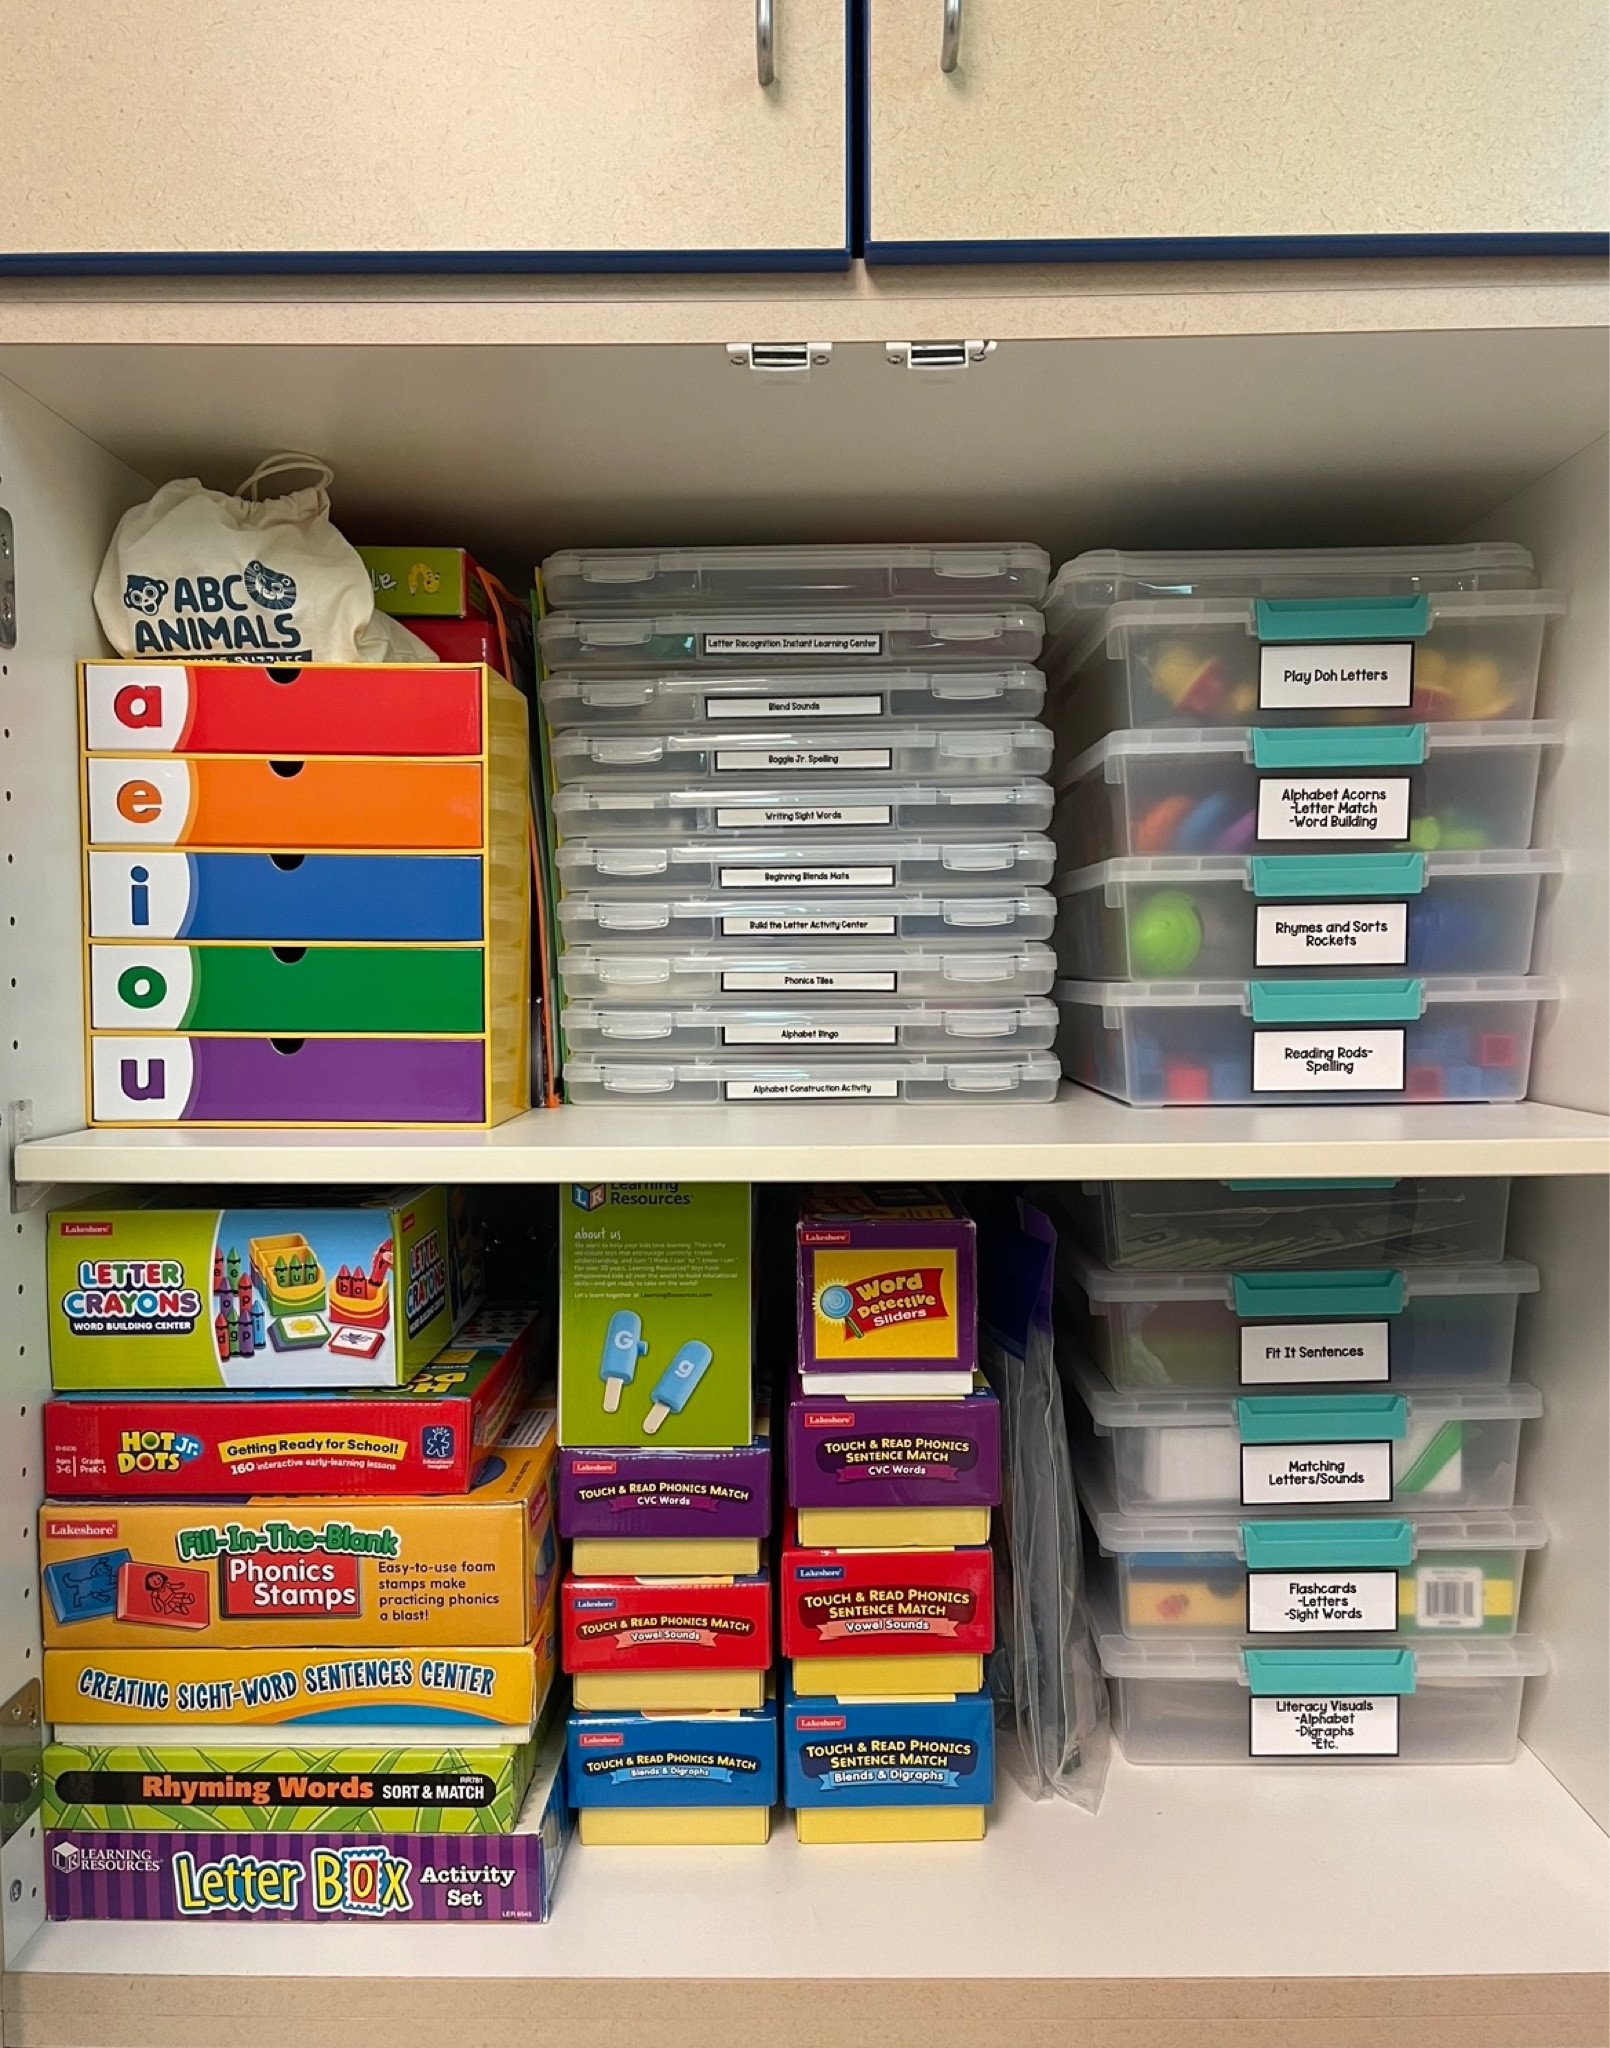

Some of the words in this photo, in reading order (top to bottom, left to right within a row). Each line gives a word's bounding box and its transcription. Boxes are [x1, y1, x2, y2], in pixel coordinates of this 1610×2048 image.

[174, 574, 248, 612] ABC
[135, 612, 300, 653] ANIMALS
[708, 640, 733, 648] Letter
[736, 639, 781, 649] Recognition
[783, 639, 812, 647] Instant
[814, 639, 848, 649] Learning
[850, 639, 876, 647] Center
[1284, 670, 1311, 685] Play
[1315, 670, 1337, 682] Doh
[1341, 670, 1388, 681] Letters
[114, 685, 162, 728] a
[769, 703, 790, 711] Blend
[769, 755, 794, 765] Boggle
[796, 755, 807, 763] Jr.
[809, 755, 838, 764] Spelling
[116, 780, 162, 824] e
[1282, 789, 1338, 804] Alphabet
[1342, 789, 1386, 800] Acorns
[1291, 802, 1334, 814] -Letter
[1338, 802, 1377, 813] Match
[765, 812, 793, 821] Writing
[795, 812, 814, 820] Sight
[816, 811, 841, 819] Words
[1289, 816, 1327, 827] -Word
[1331, 816, 1377, 830] Building
[765, 872, 801, 882] Beginning
[803, 872, 828, 880] Blends
[830, 872, 849, 880] Mats
[130, 866, 149, 926] i
[750, 921, 767, 929] Build
[769, 921, 782, 929] the
[784, 921, 808, 929] Letter
[810, 921, 840, 930] Activity
[1276, 922, 1323, 936] Rhymes
[1326, 921, 1349, 933] and
[1353, 921, 1388, 932] Sorts
[1306, 935, 1356, 946] Rockets
[118, 965, 167, 1009] o
[781, 1030, 816, 1038] Alphabet
[819, 1030, 838, 1038] Bingo
[1285, 1048, 1333, 1061] Reading
[1338, 1047, 1373, 1058] Rods-
[1306, 1060, 1354, 1075] Spelling
[121, 1059, 164, 1100] u
[753, 1085, 788, 1093] Alphabet
[790, 1084, 839, 1092] Construction
[842, 1084, 871, 1093] Activity
[611, 1183, 678, 1192] Learning
[611, 1193, 690, 1205] Resources
[575, 1228, 605, 1239] about
[610, 1232, 620, 1240] us
[82, 1263, 180, 1286] LETTER
[857, 1273, 923, 1301] Word
[65, 1292, 199, 1316] CRAYONS
[857, 1294, 936, 1319] Detective
[873, 1308, 926, 1327] Sliders
[74, 1322, 104, 1330] WORD
[106, 1322, 152, 1330] BUILDING
[1266, 1348, 1281, 1359] Fit
[1285, 1347, 1295, 1358] It
[1300, 1346, 1364, 1358] Sentences
[122, 1431, 175, 1451] HOT
[176, 1437, 199, 1455] Jr.
[227, 1443, 277, 1456] Getting
[279, 1439, 322, 1451] Ready
[325, 1439, 344, 1449] for
[347, 1440, 398, 1454] School!
[825, 1441, 865, 1453] TOUCH
[870, 1440, 878, 1448] &
[882, 1439, 911, 1448] READ
[916, 1439, 969, 1451] PHONICS
[117, 1453, 180, 1474] DOTS
[846, 1452, 903, 1463] SENTENCE
[907, 1451, 948, 1461] MATCH
[231, 1462, 255, 1475] 160
[257, 1459, 303, 1470] interactive
[306, 1458, 364, 1468] early-learning
[367, 1460, 396, 1471] lessons
[868, 1466, 889, 1475] CVC
[893, 1466, 926, 1474] Words
[1289, 1461, 1344, 1473] Matching
[1269, 1472, 1365, 1486] Letters/Sounds
[579, 1487, 615, 1500] TOUCH
[630, 1484, 656, 1492] READ
[660, 1483, 706, 1493] PHONICS
[710, 1486, 748, 1500] MATCH
[638, 1497, 656, 1505] CVC
[660, 1497, 690, 1505] Words
[50, 1524, 113, 1537] Lakeshore
[180, 1524, 398, 1556] Fill-In-The-Blank
[229, 1559, 334, 1583] Phonics
[379, 1561, 457, 1576] Easy-to-use
[461, 1561, 496, 1572] foam
[379, 1579, 426, 1591] stamps
[431, 1578, 466, 1589] make
[1289, 1583, 1356, 1594] Flashcards
[254, 1583, 356, 1610] Stamps
[379, 1594, 444, 1608] practicing
[449, 1594, 499, 1607] phonics
[805, 1594, 850, 1607] TOUCH
[856, 1593, 864, 1602] &
[870, 1590, 903, 1601] READ
[909, 1590, 969, 1603] PHONICS
[1298, 1596, 1348, 1607] -Letters
[380, 1612, 387, 1621] a
[393, 1610, 429, 1620] blast!
[830, 1606, 893, 1618] SENTENCE
[898, 1603, 945, 1615] MATCH
[1284, 1608, 1318, 1622] -Sight
[1323, 1608, 1362, 1619] Words
[846, 1622, 883, 1632] Vowel
[886, 1620, 929, 1630] Sounds
[80, 1668, 168, 1709] CREATING
[178, 1671, 297, 1710] SIGHT-WORD
[305, 1659, 412, 1693] SENTENCES
[422, 1660, 495, 1695] CENTER
[1276, 1701, 1327, 1714] Literacy
[1330, 1700, 1373, 1711] Visuals
[1295, 1713, 1355, 1727] -Alphabet
[1295, 1726, 1354, 1739] -Digraphs
[806, 1745, 853, 1757] TOUCH
[857, 1743, 867, 1752] &
[871, 1741, 905, 1752] READ
[911, 1740, 970, 1755] PHONICS
[831, 1756, 895, 1768] SENTENCE
[900, 1754, 947, 1766] MATCH
[834, 1771, 874, 1782] Blends
[878, 1770, 886, 1779] &
[890, 1770, 943, 1784] Digraphs
[143, 1775, 270, 1804] Rhyming
[278, 1776, 373, 1798] Words
[383, 1785, 419, 1799] SORT
[421, 1786, 433, 1799] &
[437, 1785, 484, 1799] MATCH
[81, 1850, 152, 1860] LEARNING
[81, 1860, 160, 1871] RESOURCES
[177, 1857, 300, 1908] Letter
[316, 1853, 408, 1908] BOX
[420, 1866, 515, 1886] Activity
[448, 1890, 482, 1906] Set
